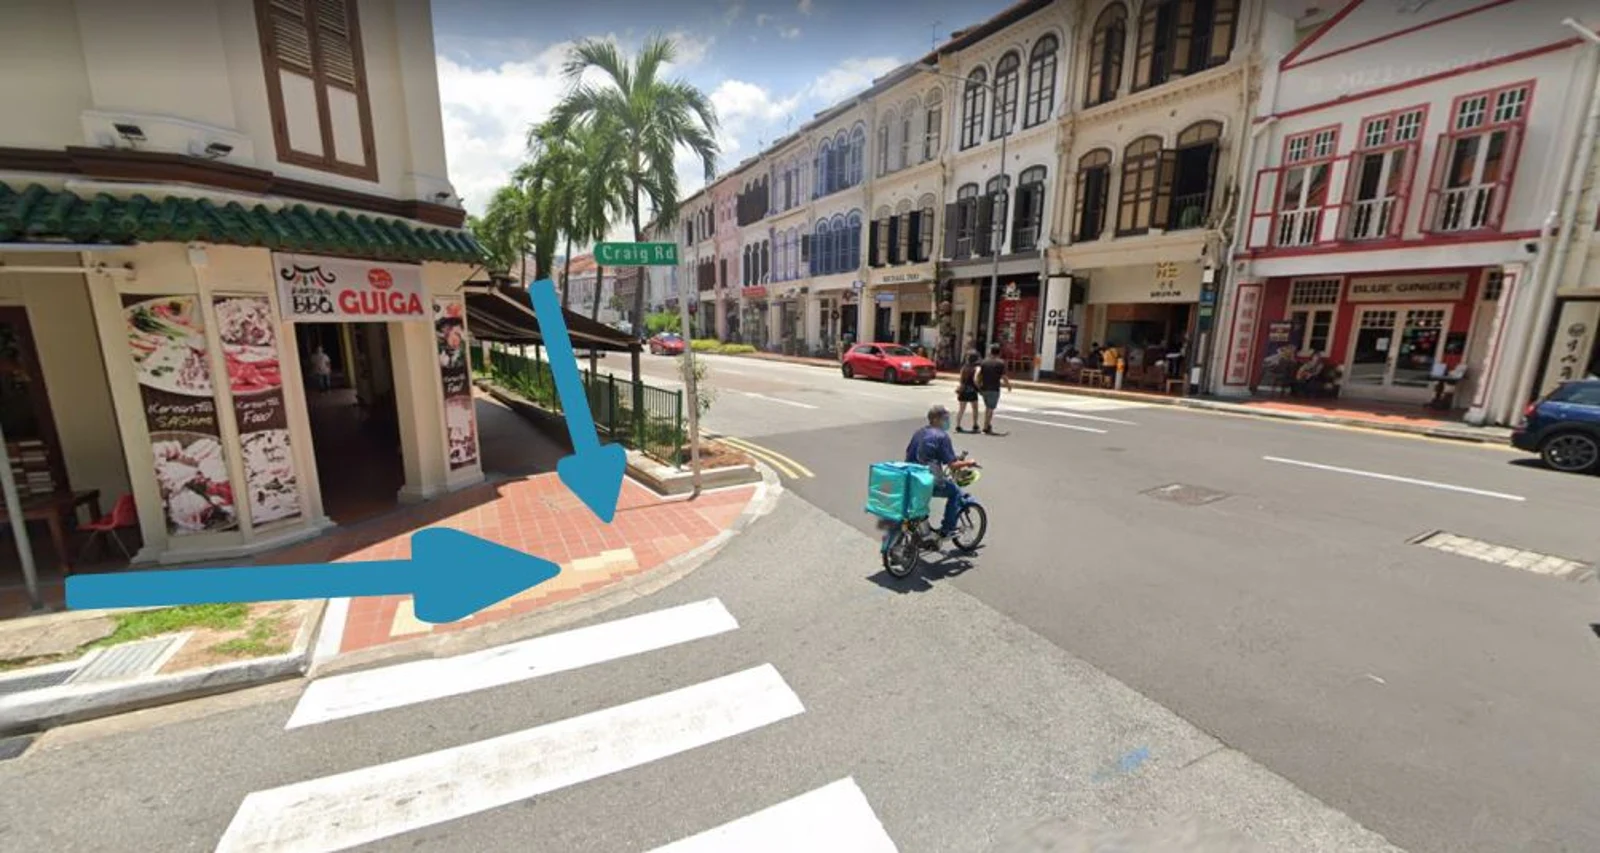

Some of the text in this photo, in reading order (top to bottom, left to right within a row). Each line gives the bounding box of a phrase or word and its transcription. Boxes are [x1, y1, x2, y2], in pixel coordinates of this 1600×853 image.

[602, 245, 674, 264] Craig Rd
[1353, 280, 1462, 294] BLUE GINGER
[338, 289, 424, 315] GUIGA
